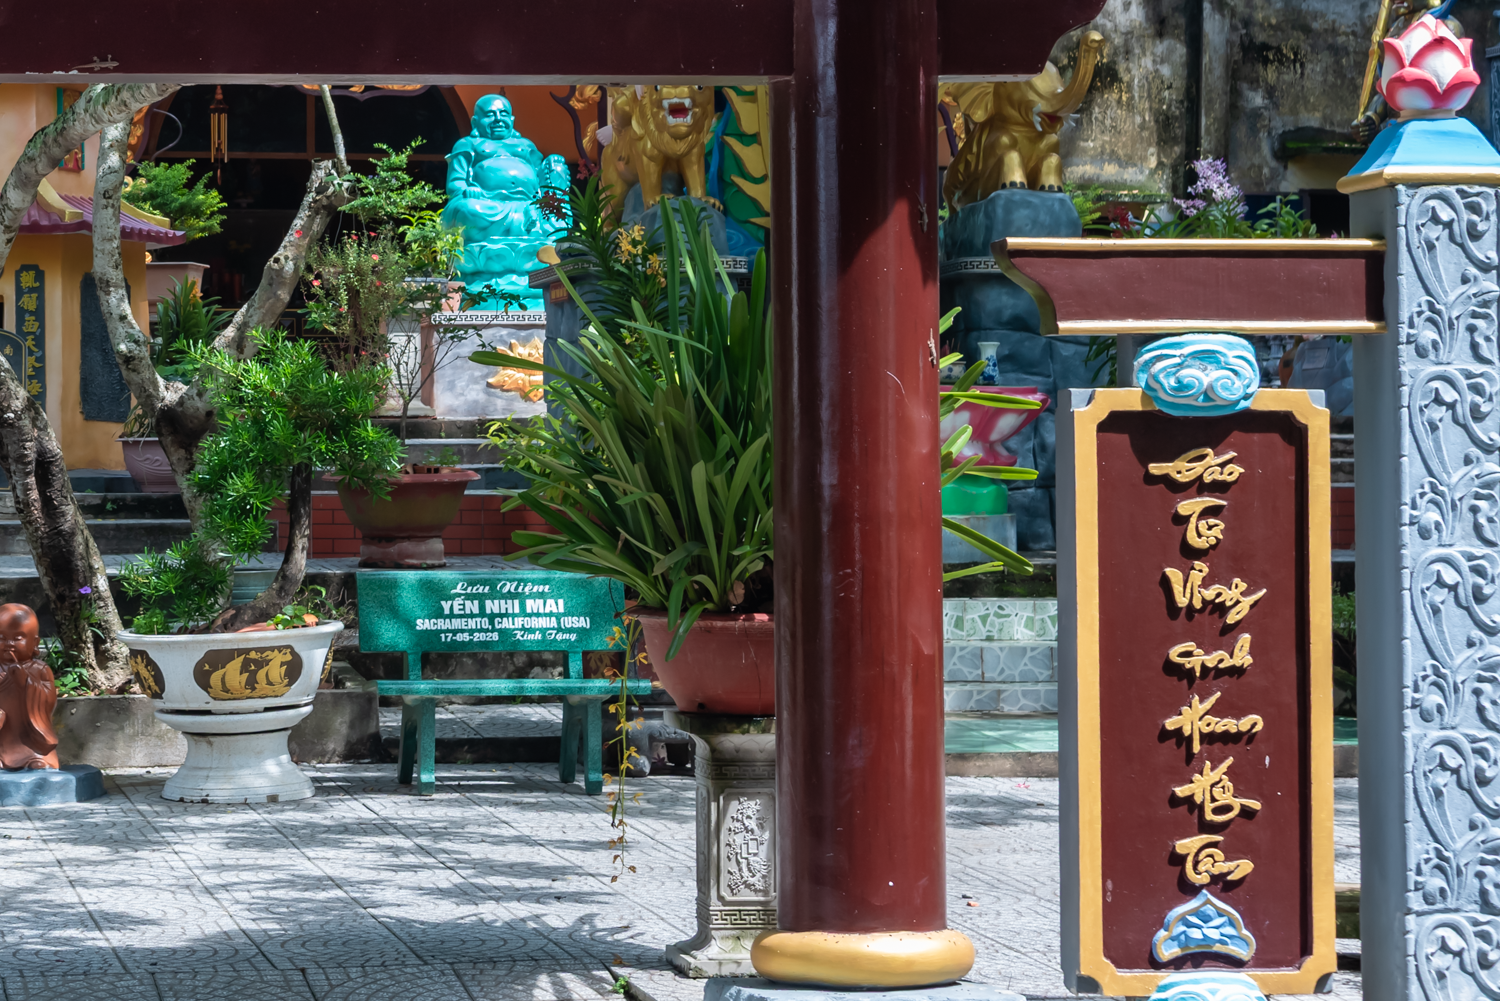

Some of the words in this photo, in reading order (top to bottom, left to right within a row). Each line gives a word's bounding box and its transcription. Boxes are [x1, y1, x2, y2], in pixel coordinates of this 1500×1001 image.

[450, 581, 491, 594] Lưu
[497, 580, 552, 595] Niệm
[440, 596, 479, 614] YẾN
[485, 599, 520, 614] NHI
[525, 598, 564, 613] MAI
[416, 618, 491, 630] SACRAMENTO,
[494, 616, 557, 629] CALIFORNIA
[560, 616, 591, 629] (USA)
[1164, 691, 1264, 755] Hoan
